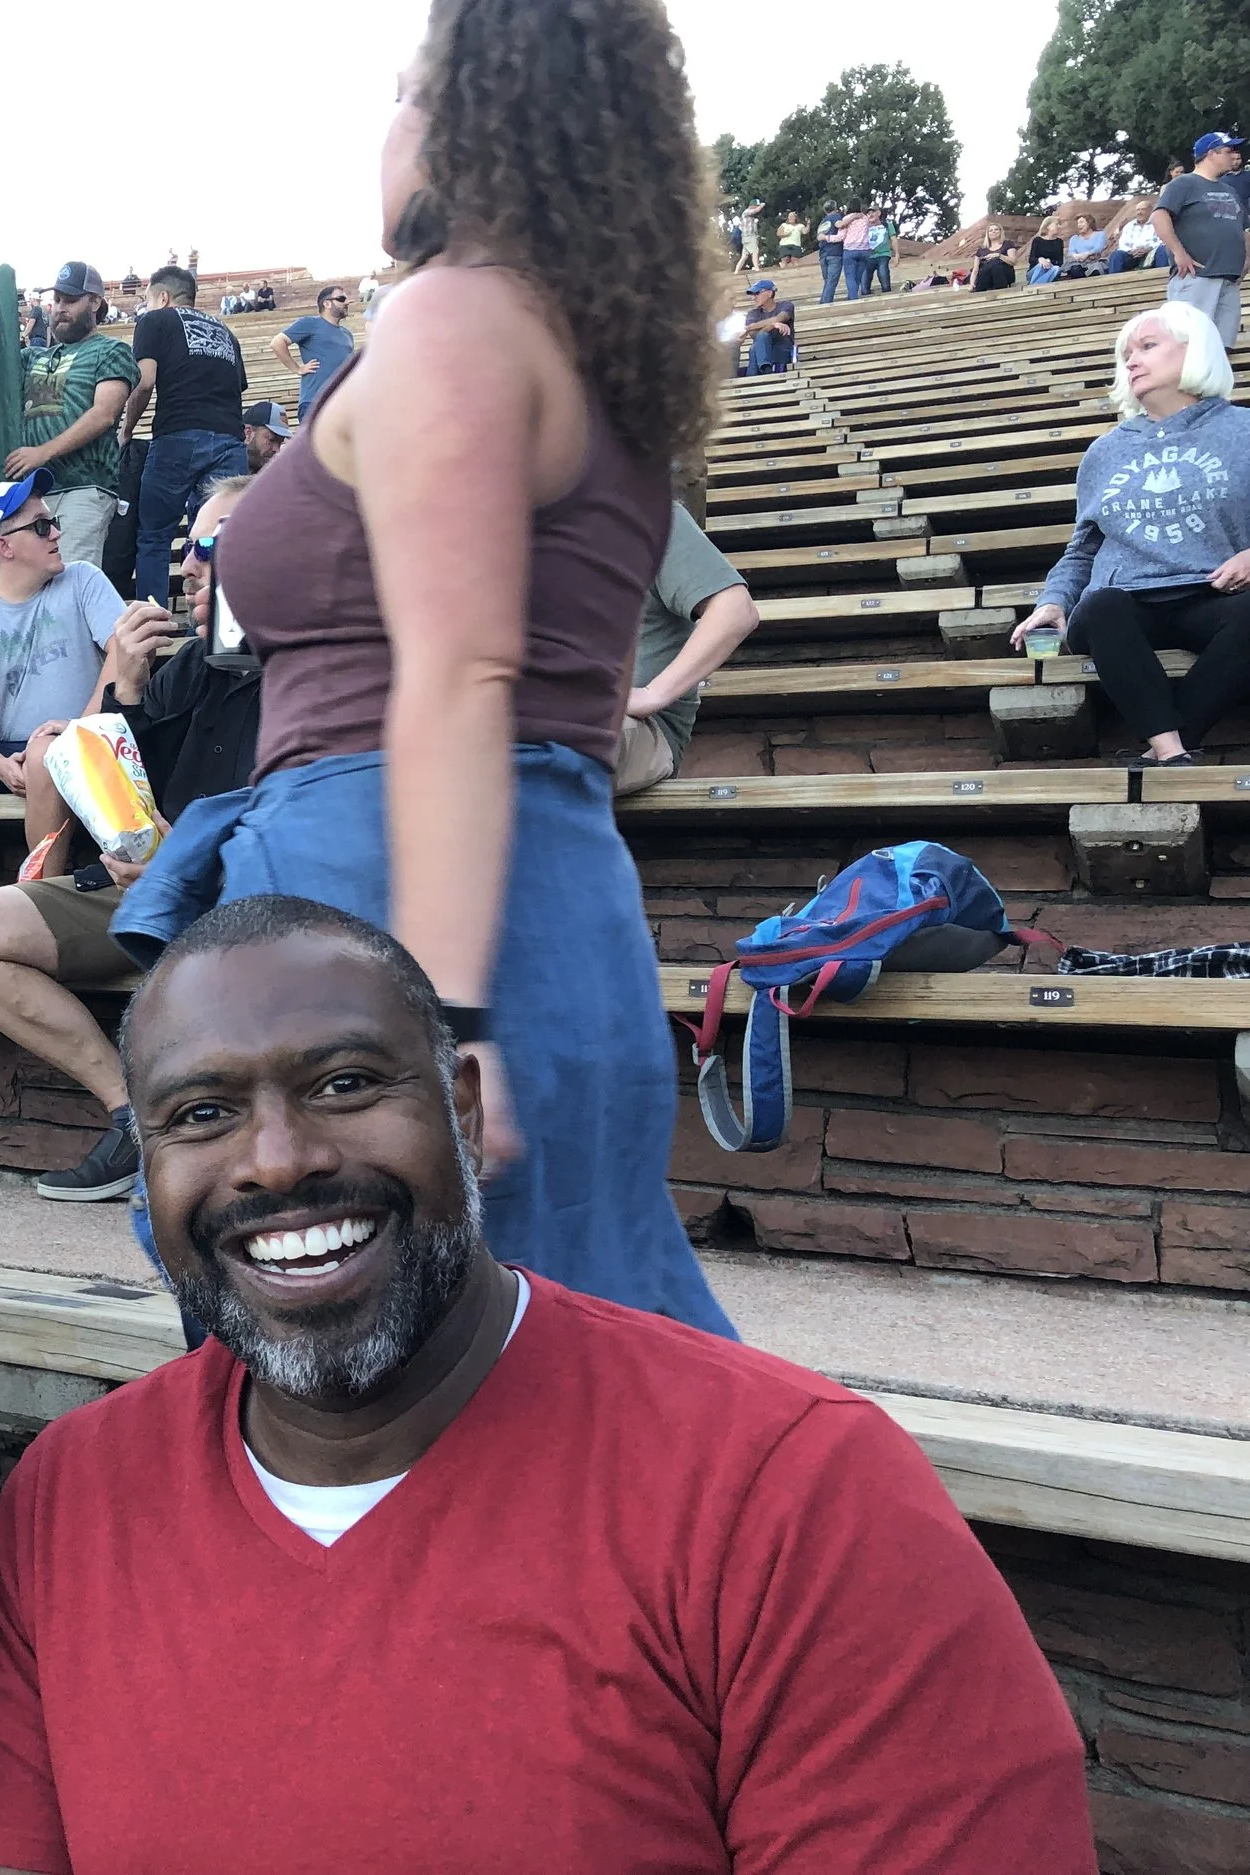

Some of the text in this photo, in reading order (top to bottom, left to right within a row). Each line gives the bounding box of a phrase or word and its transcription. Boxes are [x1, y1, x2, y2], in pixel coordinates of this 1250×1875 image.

[1102, 446, 1229, 502] VOYAGAIRE
[1102, 488, 1228, 516] CRANE LAKE
[1146, 511, 1156, 519] OF
[1161, 508, 1176, 516] THE
[1125, 513, 1205, 544] 1959
[961, 783, 976, 791] 120
[1043, 990, 1060, 1001] 119
